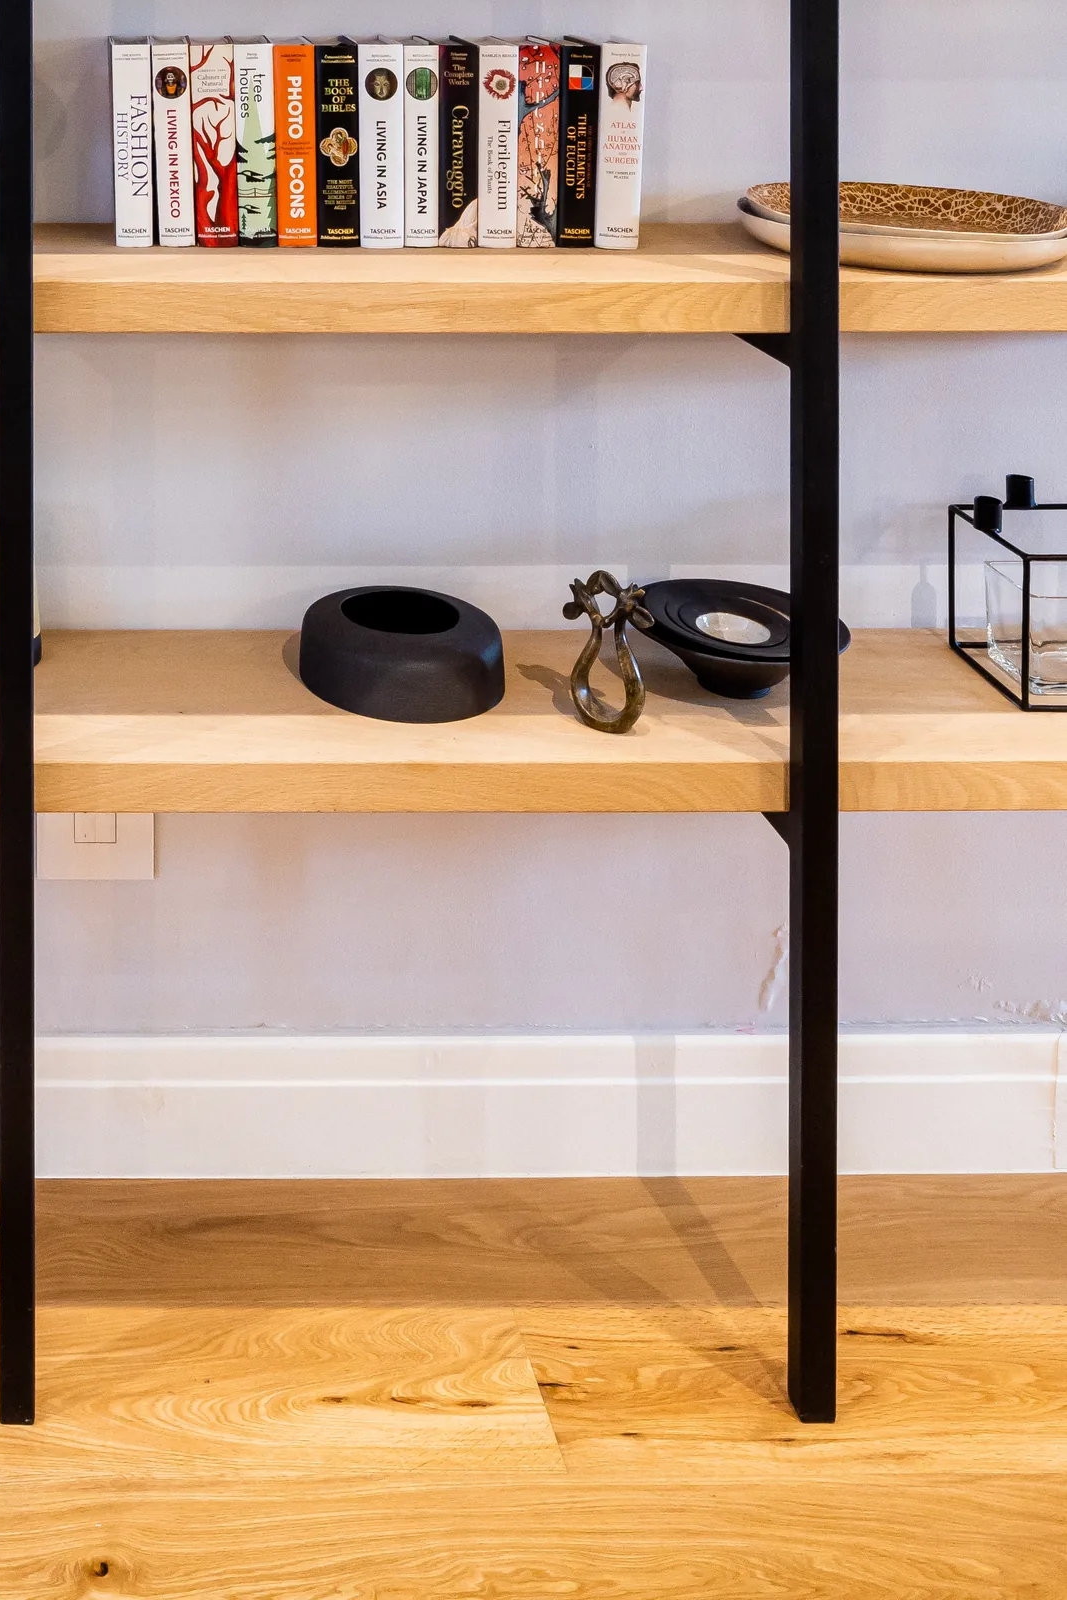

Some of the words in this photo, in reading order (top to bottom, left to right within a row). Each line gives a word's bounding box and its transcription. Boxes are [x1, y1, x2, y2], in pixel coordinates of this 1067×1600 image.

[252, 73, 266, 103] tree
[327, 78, 350, 87] THE
[443, 70, 474, 79] Complete
[239, 68, 257, 119] houses
[324, 87, 354, 96] BOOK
[332, 95, 347, 104] OF
[287, 75, 304, 139] PHOTO
[321, 103, 357, 113] BIBLES
[166, 109, 178, 150] LIVING
[417, 115, 428, 156] LIVING
[566, 126, 577, 142] OF
[577, 113, 587, 137] THE
[607, 135, 639, 143] HUMAN
[117, 112, 129, 181] HISTORY
[130, 94, 149, 198] FASHION
[376, 120, 387, 162] LIVING
[602, 142, 643, 151] ANATOMY
[167, 154, 179, 166] IN
[376, 165, 387, 178] IN
[417, 160, 428, 173] IN
[446, 105, 469, 209] Caravaggio
[494, 119, 511, 211] Florilegium
[565, 145, 576, 187] EUCLID
[576, 140, 586, 200] ELEMENTS
[604, 156, 639, 164] SURGERY
[169, 170, 181, 218] MEXICO
[289, 158, 306, 219] ICONS
[376, 181, 387, 210] ASIA
[417, 176, 428, 214] JAPAN
[486, 174, 494, 195] Plants
